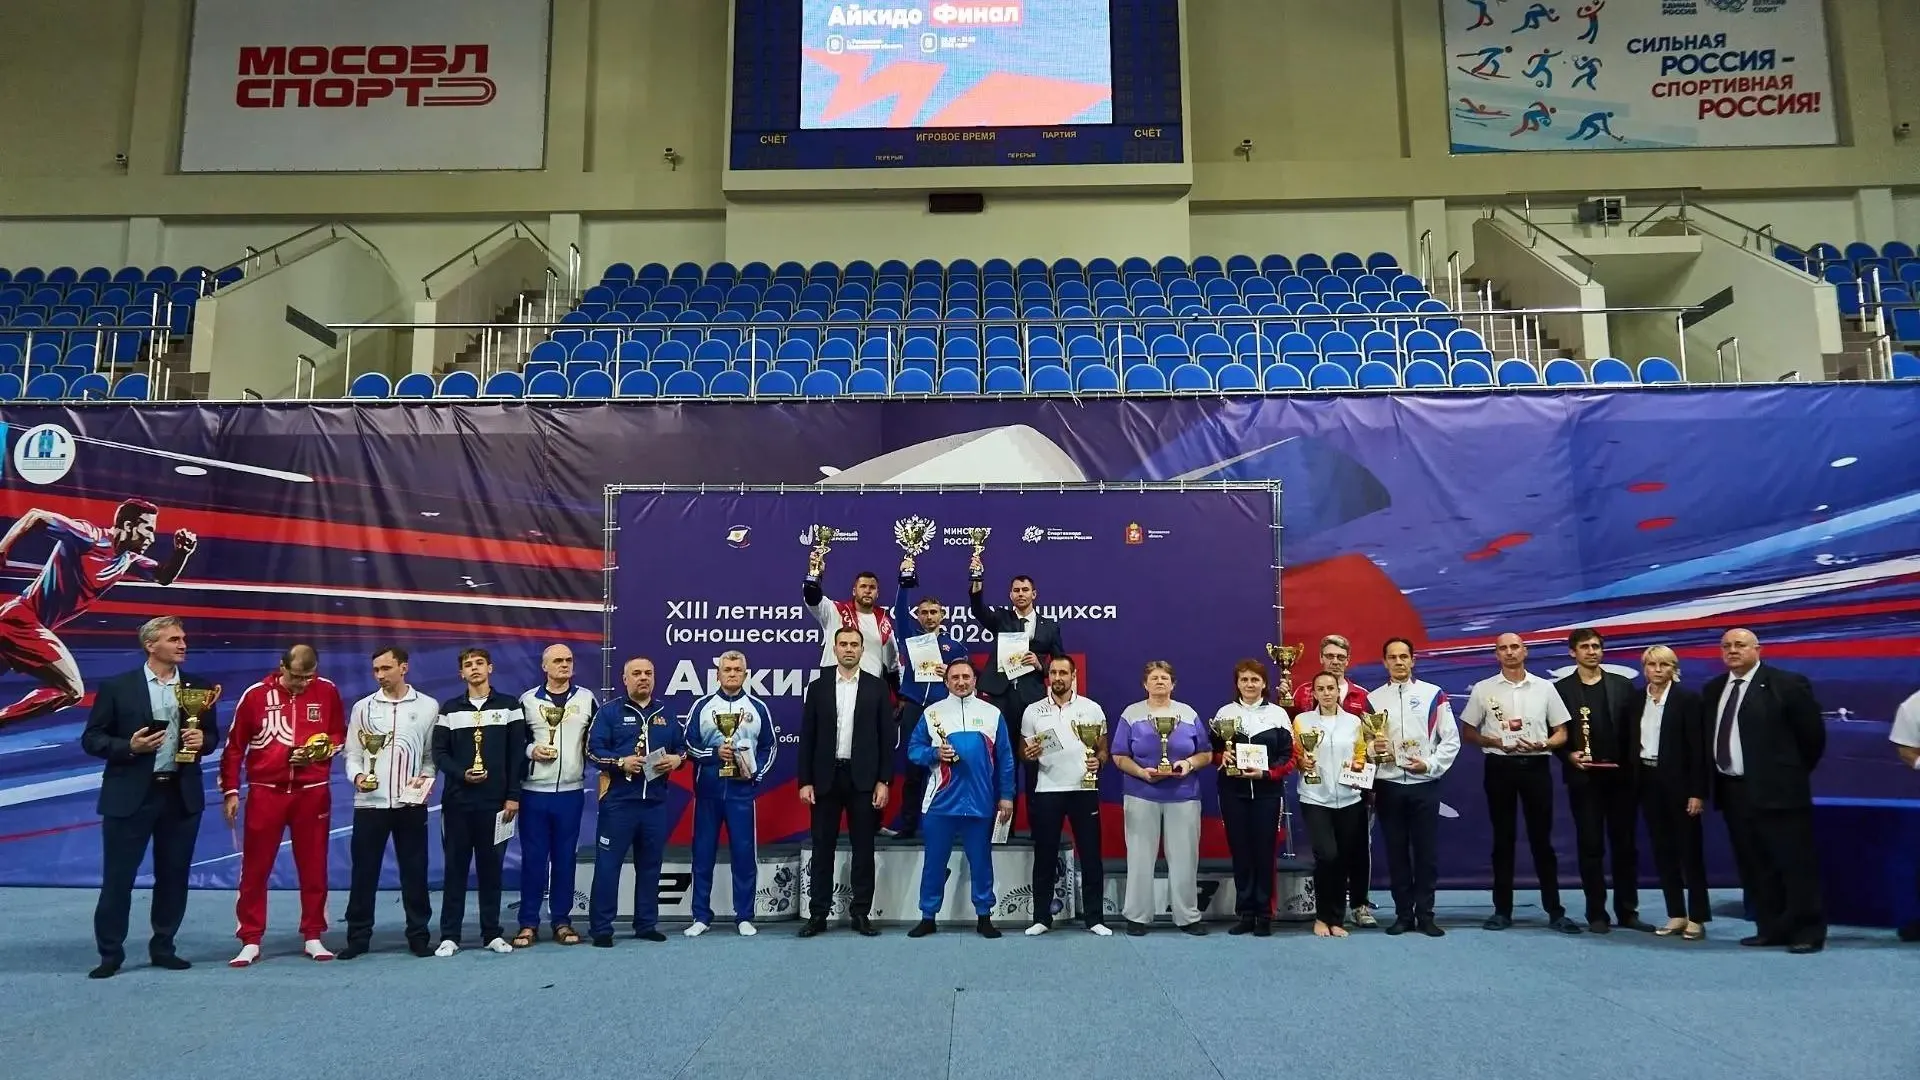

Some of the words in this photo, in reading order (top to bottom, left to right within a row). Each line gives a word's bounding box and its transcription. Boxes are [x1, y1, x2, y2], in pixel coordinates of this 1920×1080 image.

[828, 4, 923, 29] Айкидо
[933, 3, 1018, 24] Финал
[1627, 33, 1727, 54] СИЛЬНАЯ
[238, 44, 490, 75] МОСОБЛ
[1661, 49, 1777, 76] РОССИЯ
[236, 77, 434, 108] СПОРТ
[1652, 74, 1794, 98] СПОРТИВНАЯ
[1699, 92, 1821, 120] РОССИЯ!
[760, 134, 788, 144] СЧЁТ
[916, 132, 960, 142] ИГРОВОЕ
[963, 131, 996, 141] ВРЕМЯ
[1042, 131, 1077, 139] ПАРТИЯ
[1134, 128, 1162, 138] СЧЁТ
[943, 537, 979, 545] РОССИ
[666, 601, 708, 619] XIII
[715, 605, 803, 620] летняя
[989, 605, 1117, 622] щихся
